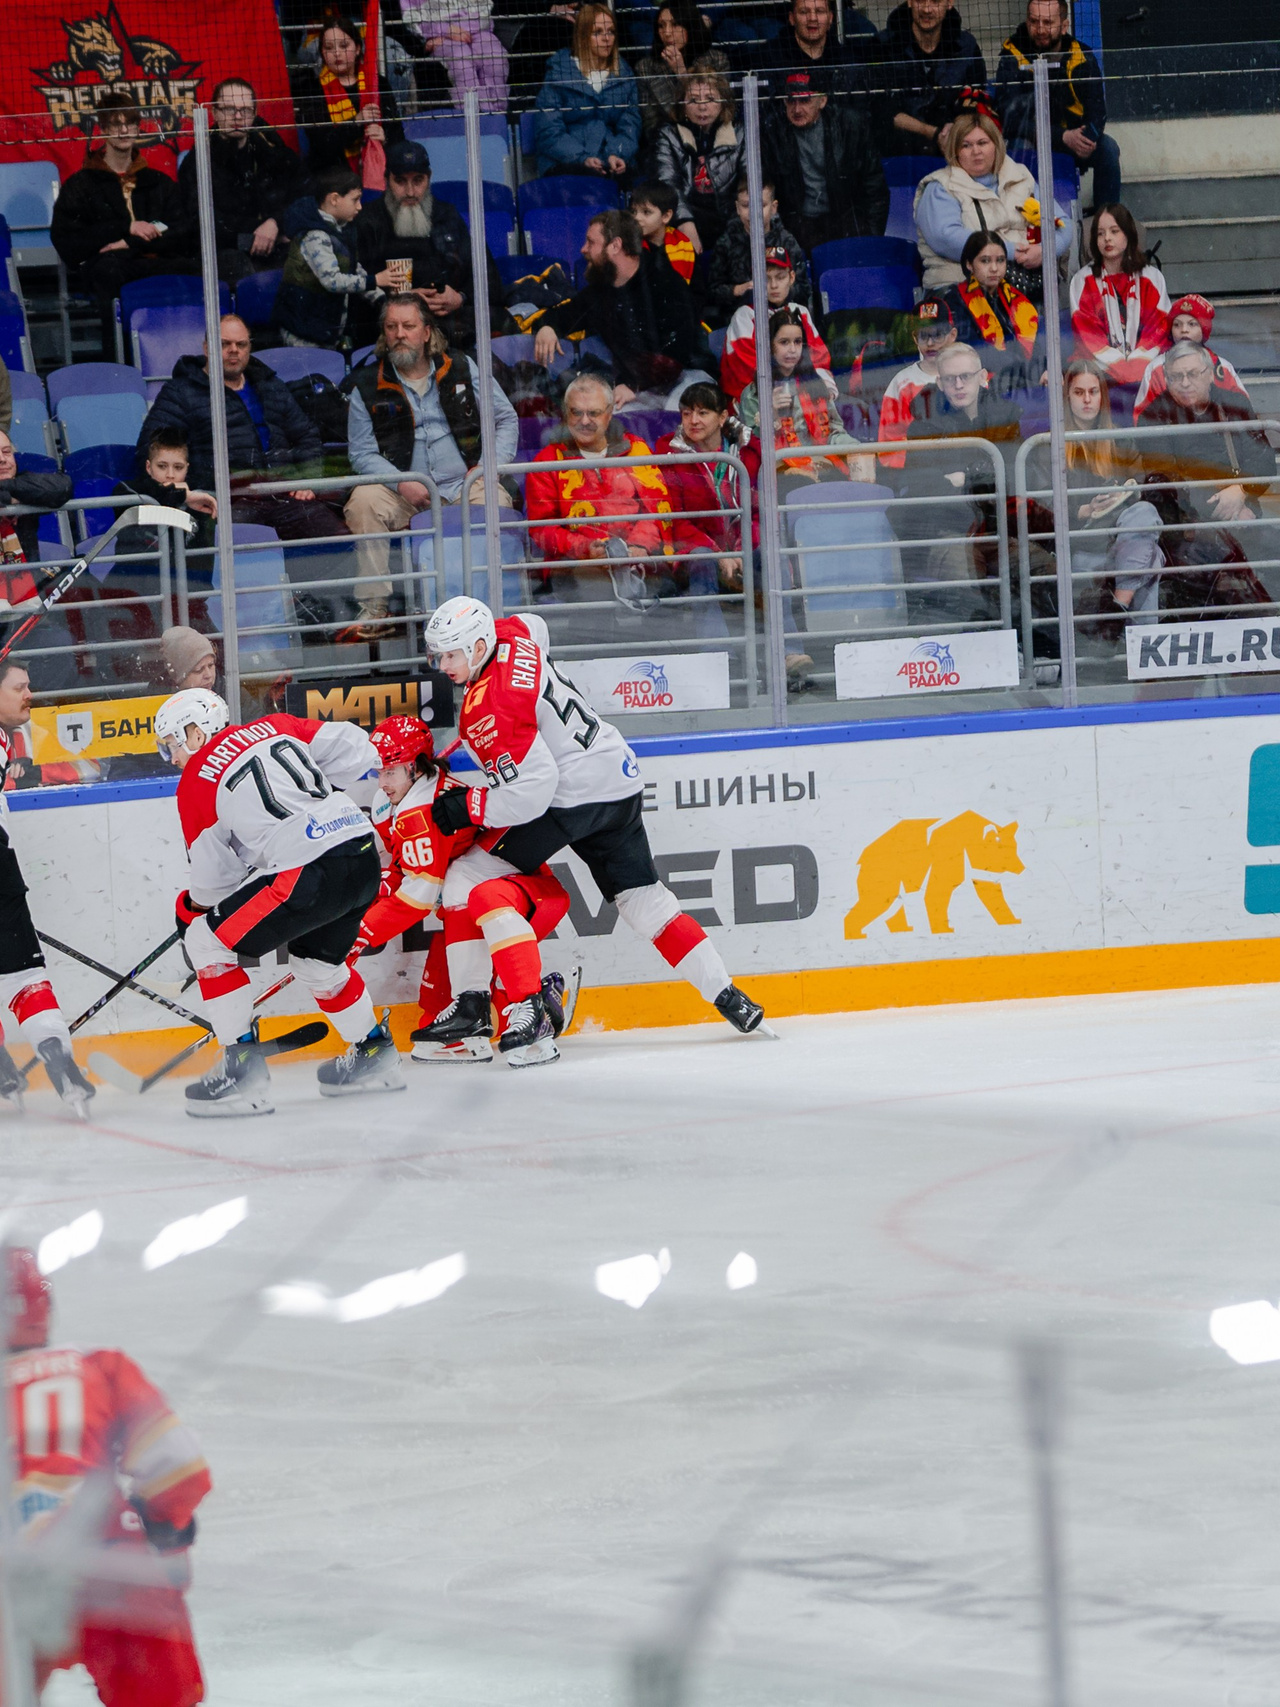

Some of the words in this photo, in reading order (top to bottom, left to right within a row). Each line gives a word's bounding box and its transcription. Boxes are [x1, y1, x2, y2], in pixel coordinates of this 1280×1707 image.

[896, 661, 938, 677] АВТО
[908, 672, 961, 689] РАДИО
[612, 680, 652, 696] АВТО
[623, 692, 674, 709] РАДИО
[100, 715, 157, 740] БАН
[198, 721, 279, 783] MARTYNOV
[224, 739, 333, 821] 70
[675, 771, 817, 810] ШИНЫ
[401, 837, 434, 868] 86
